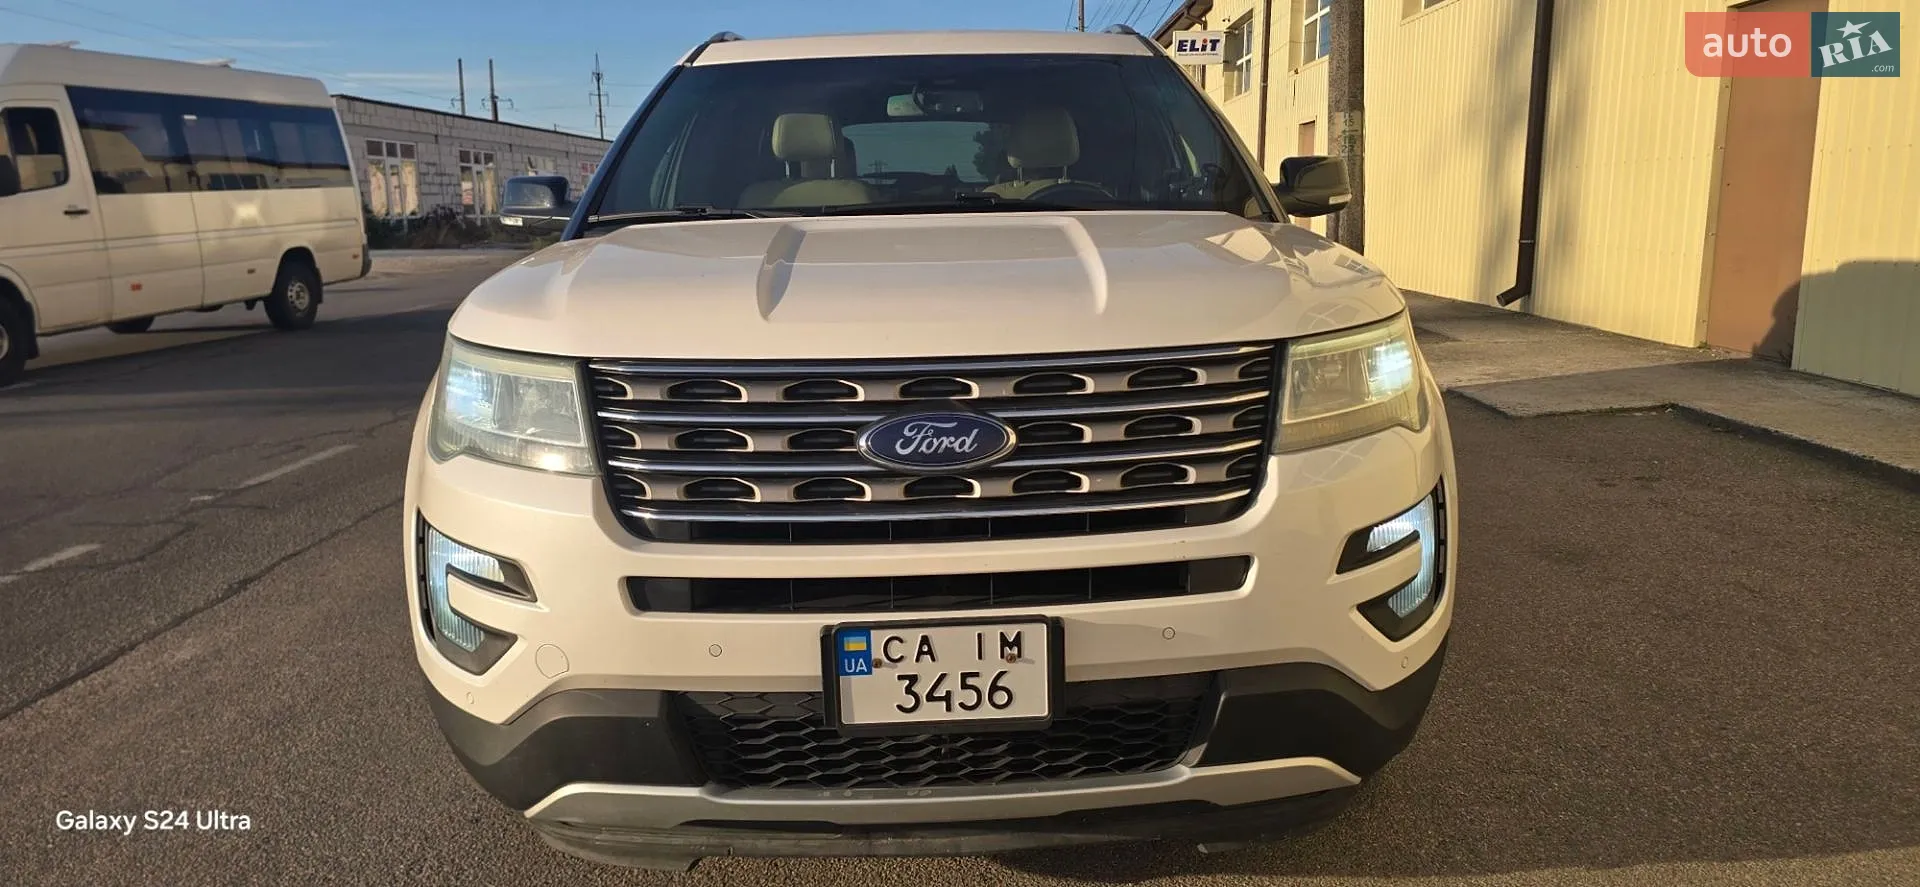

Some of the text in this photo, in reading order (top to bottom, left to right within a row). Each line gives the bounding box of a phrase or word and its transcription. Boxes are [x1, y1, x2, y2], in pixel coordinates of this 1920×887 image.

[895, 421, 979, 455] Ford
[882, 630, 1022, 663] CA IM
[844, 658, 868, 673] UA
[895, 670, 1014, 714] 3456
